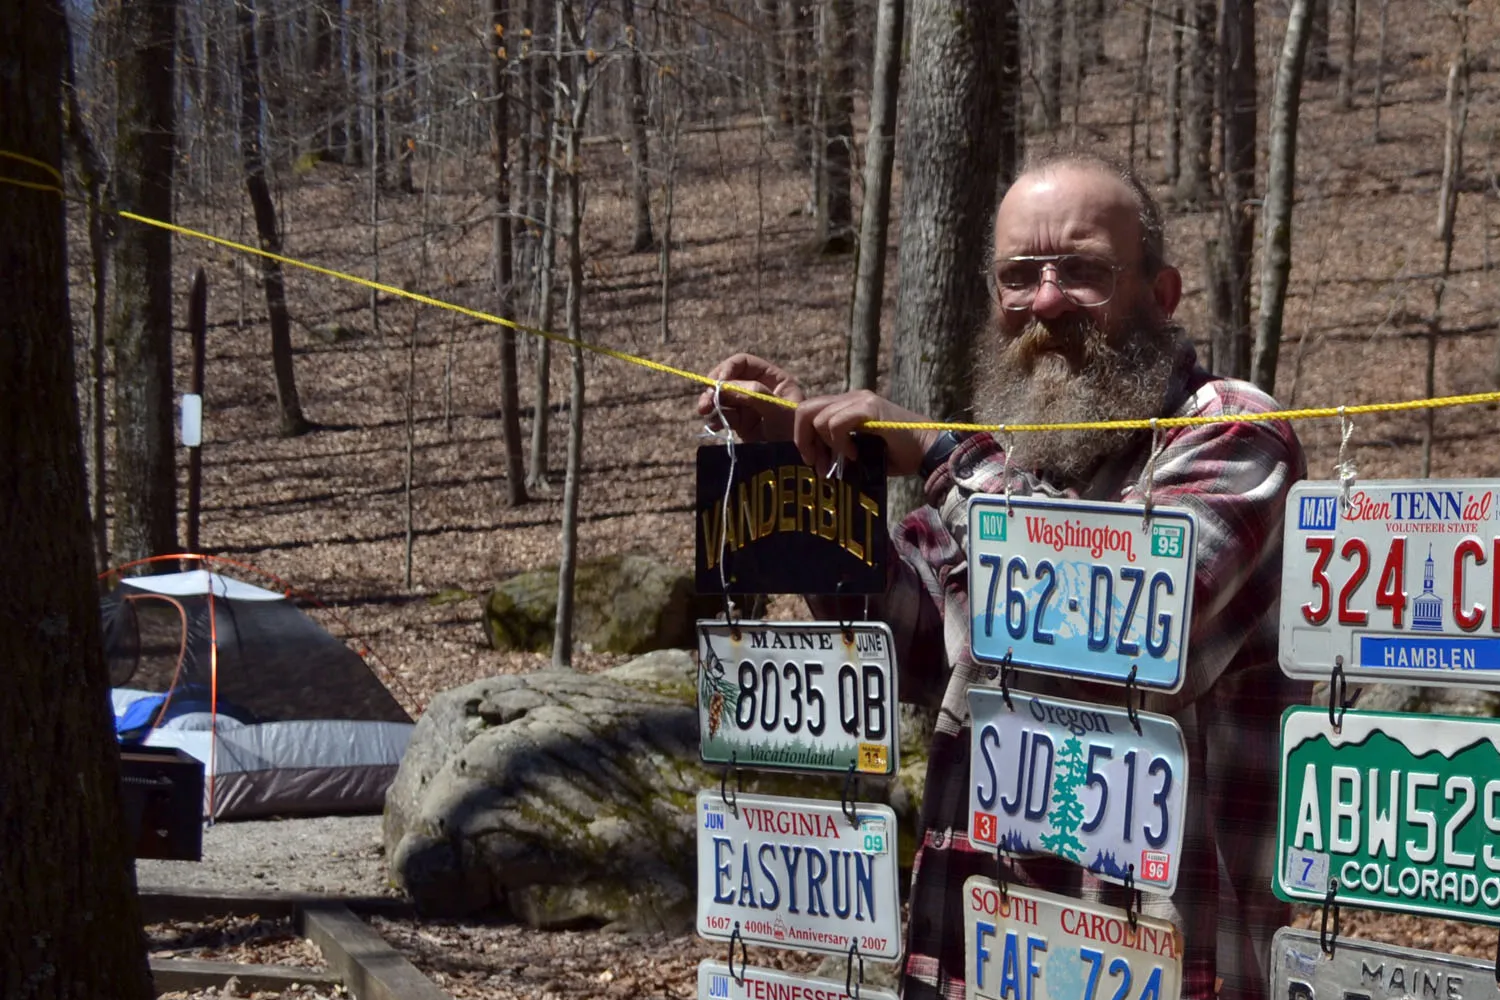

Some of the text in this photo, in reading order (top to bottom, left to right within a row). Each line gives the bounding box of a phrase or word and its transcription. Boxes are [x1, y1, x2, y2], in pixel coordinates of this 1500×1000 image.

[702, 465, 879, 570] VANDERBILT
[983, 515, 1003, 535] NOV
[1301, 499, 1335, 527] MAY
[1025, 516, 1136, 562] Washington
[1386, 523, 1478, 533] VOLUNTEER STATE
[1158, 536, 1180, 556] 95
[1301, 537, 1407, 628] 324
[751, 632, 833, 650] MAINE
[857, 634, 882, 652] JUNE
[1384, 647, 1475, 668] HAMBLEN
[736, 661, 886, 740] 8035 QB
[1029, 697, 1113, 737] Oregon
[977, 725, 1172, 847] SJD 513
[704, 813, 724, 830] JUN
[742, 807, 840, 839] VIRGINIA
[864, 835, 883, 851] 09
[712, 837, 875, 923] EASYRUN
[1148, 862, 1163, 878] 96
[1302, 858, 1314, 881] 7
[744, 921, 887, 951] 400th Anniversary 2007
[972, 887, 1177, 960] SOUTH CAROLINA
[709, 976, 728, 998] JUN
